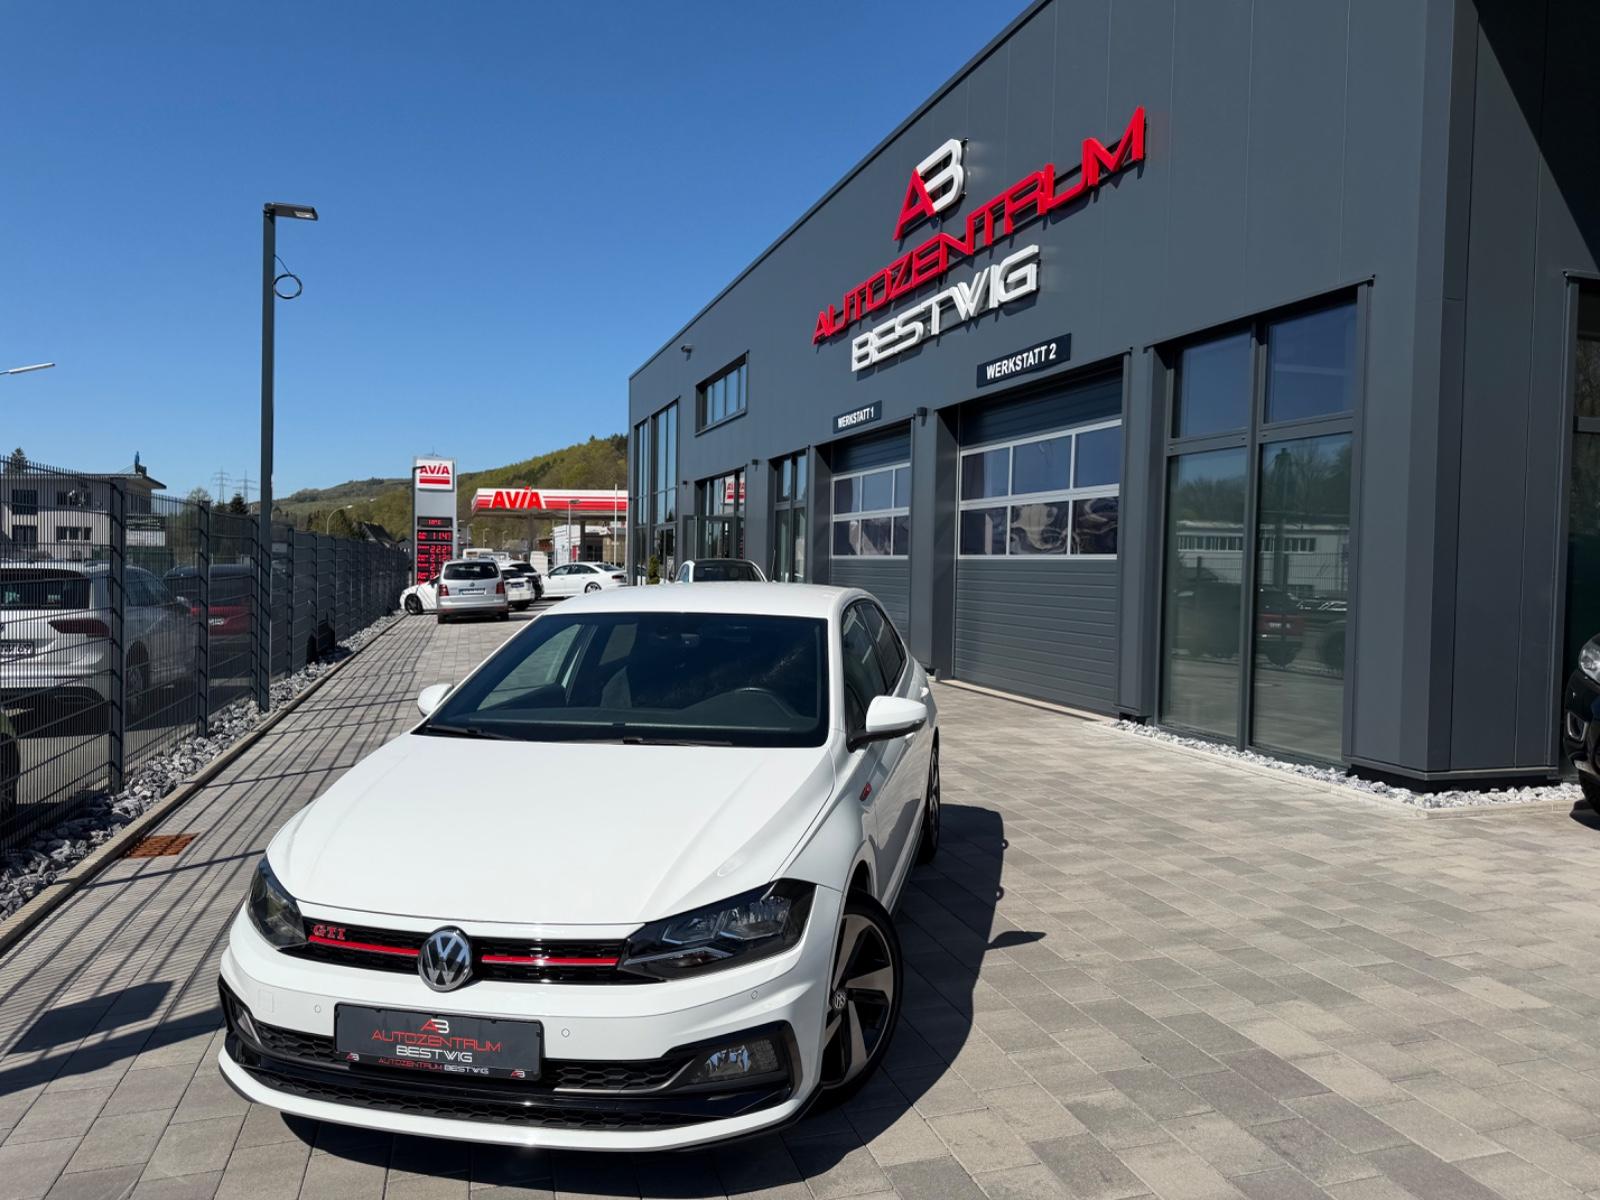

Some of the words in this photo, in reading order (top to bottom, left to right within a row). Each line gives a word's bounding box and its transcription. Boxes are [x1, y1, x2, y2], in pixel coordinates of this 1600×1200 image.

[813, 106, 1146, 345] AUTOZENTRUM
[851, 244, 1040, 372] BESTWIG
[986, 345, 1048, 380] WERKSTATT
[1049, 343, 1057, 360] 2
[837, 407, 871, 429] WERKSTATT
[312, 924, 346, 941] GTI
[371, 1029, 502, 1053] AUTOZENTRUM
[396, 1044, 473, 1063] BESTWIG
[378, 1058, 444, 1072] AUTOZENTRUM
[444, 1064, 489, 1075] BESTWIG
